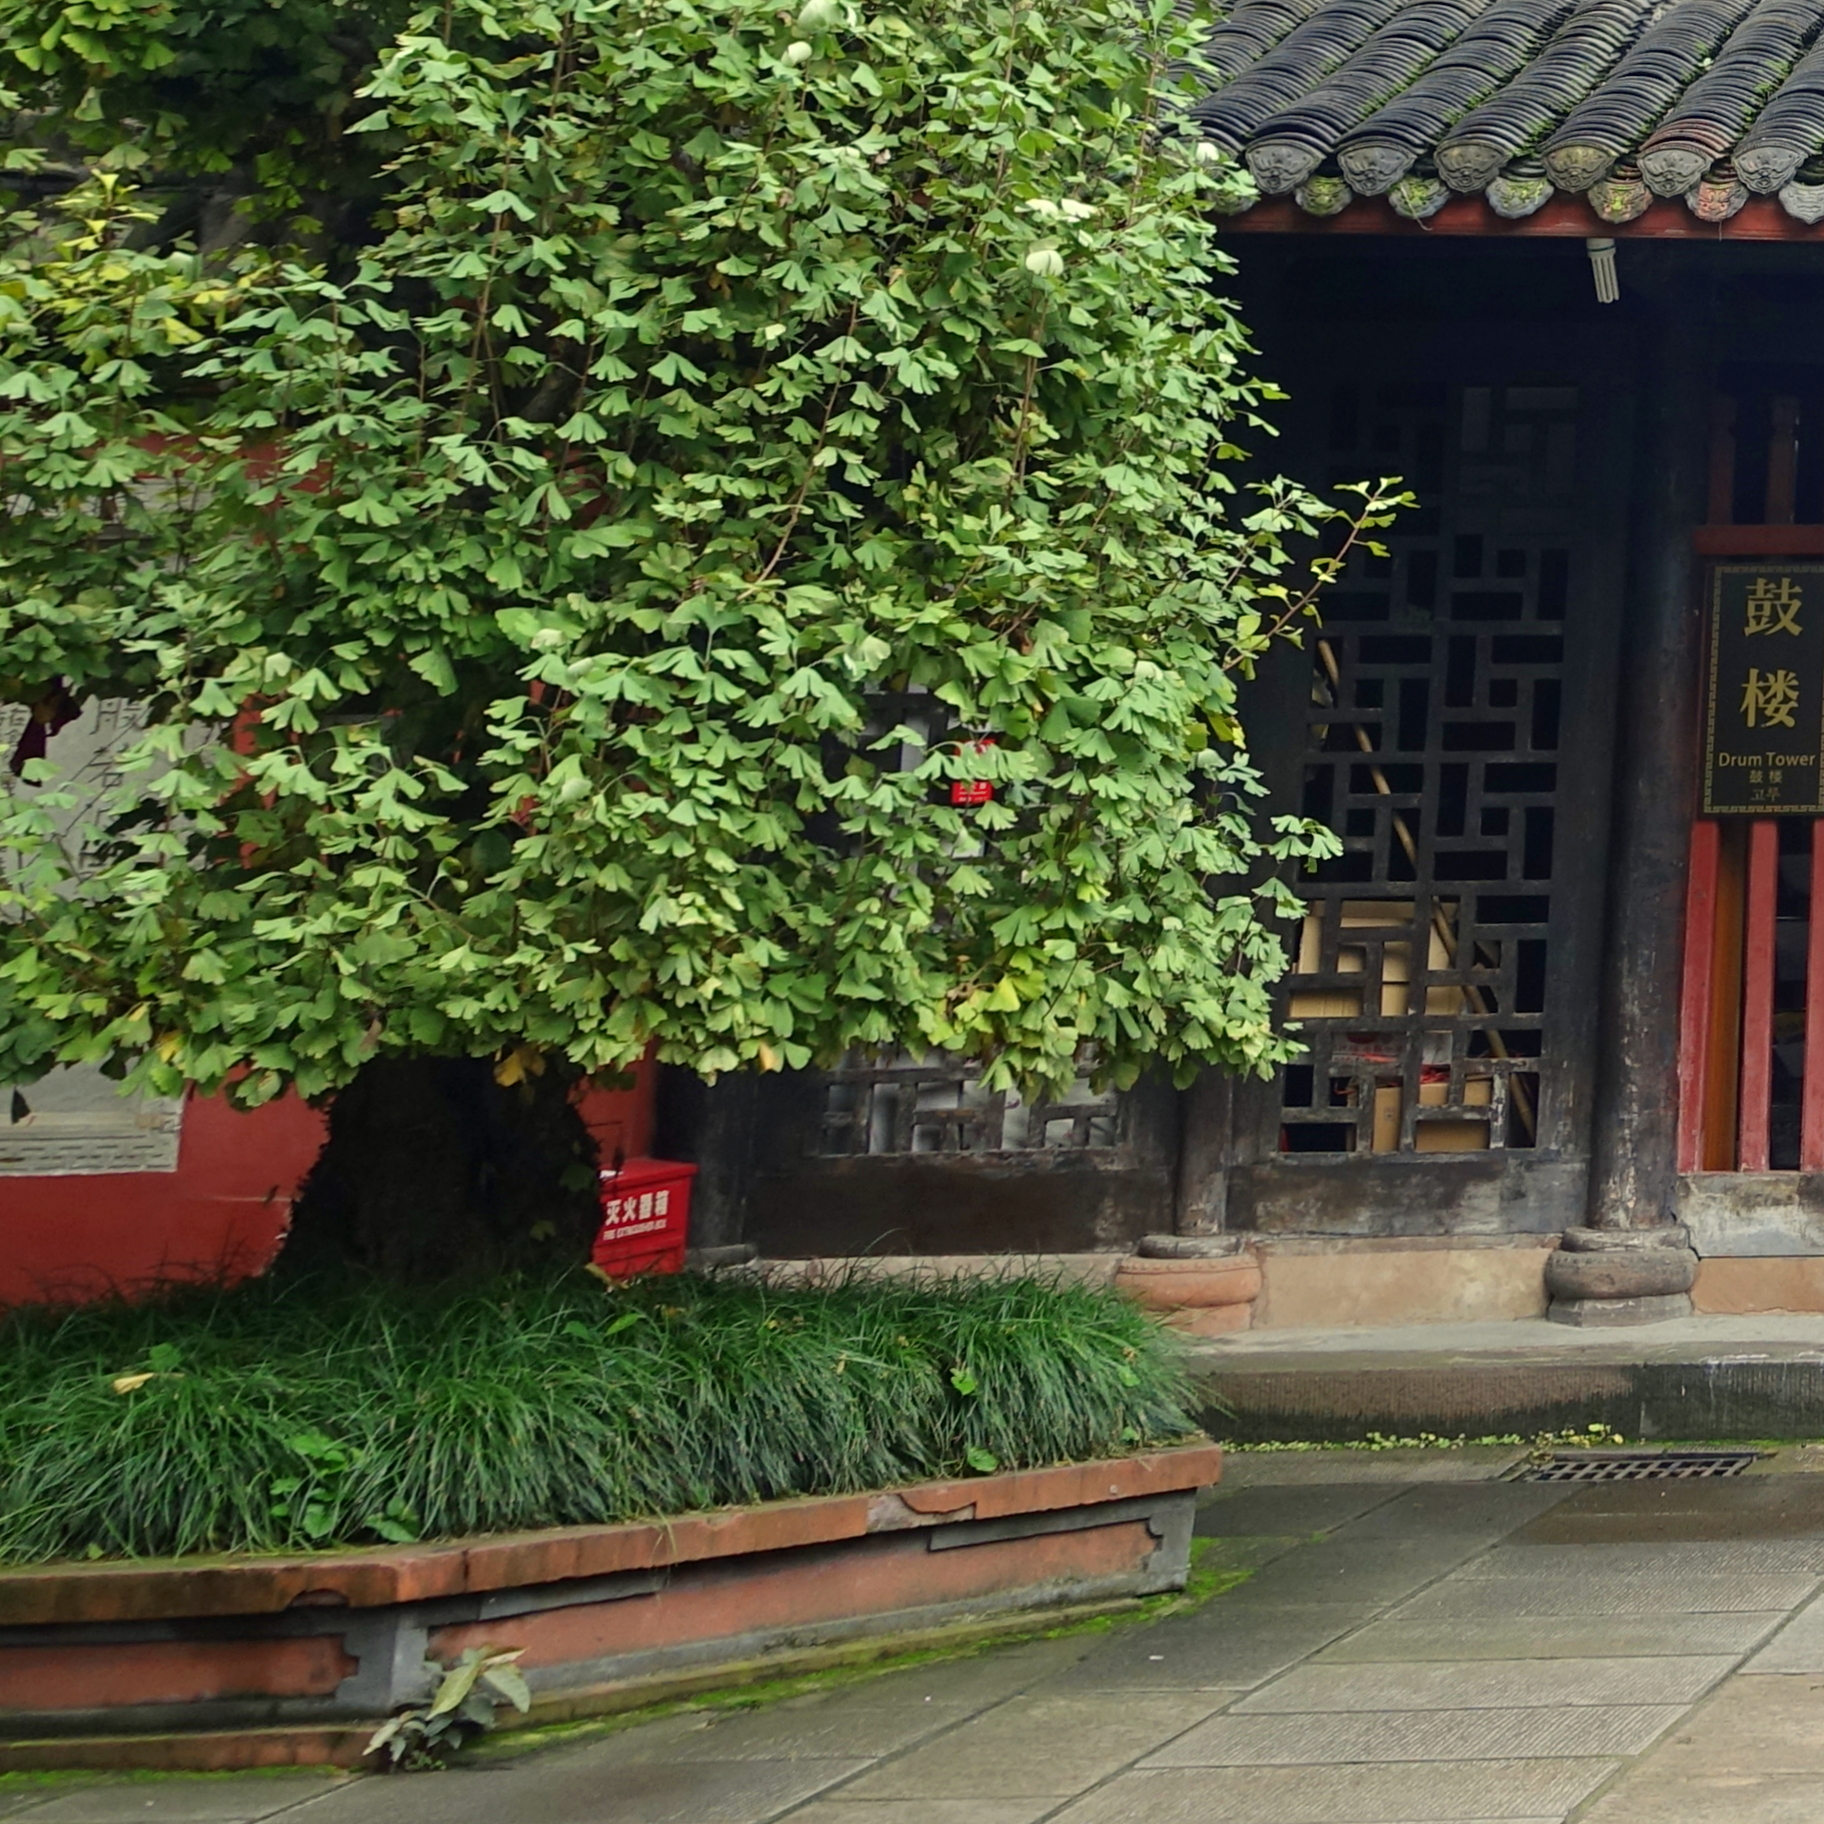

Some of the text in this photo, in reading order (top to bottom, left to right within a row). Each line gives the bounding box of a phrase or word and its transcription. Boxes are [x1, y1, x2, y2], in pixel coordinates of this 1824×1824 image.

[1740, 577, 1803, 728] 鼓楼
[1718, 751, 1817, 768] Drum Tower
[605, 1189, 670, 1226] 灭火器箱
